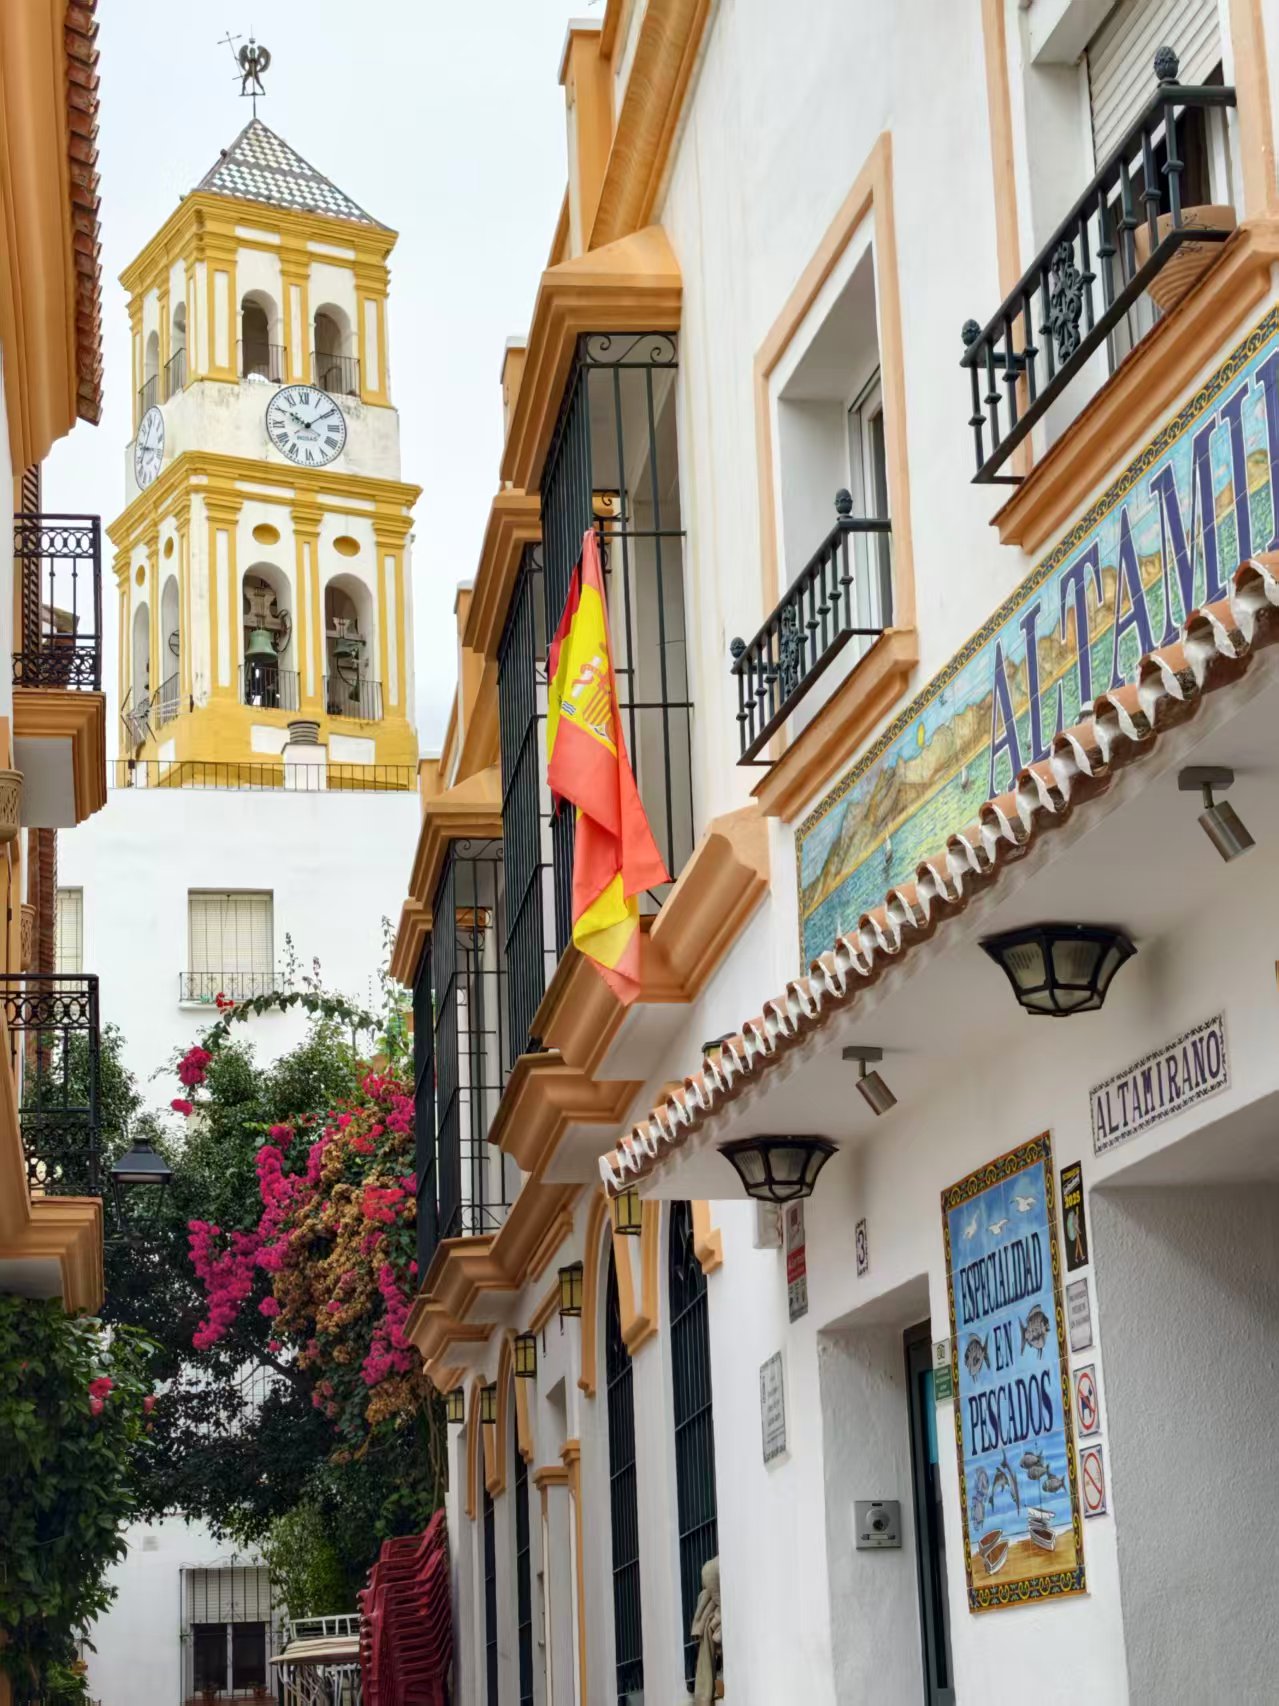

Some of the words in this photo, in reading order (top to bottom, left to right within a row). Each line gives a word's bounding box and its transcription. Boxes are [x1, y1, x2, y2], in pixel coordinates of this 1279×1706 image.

[1096, 1029, 1222, 1142] ALTAMIRANO
[857, 1229, 866, 1266] 3
[959, 1231, 1043, 1326] ESPECIALIDAD
[993, 1320, 1014, 1372] EN
[968, 1369, 1054, 1457] PESCADOS
